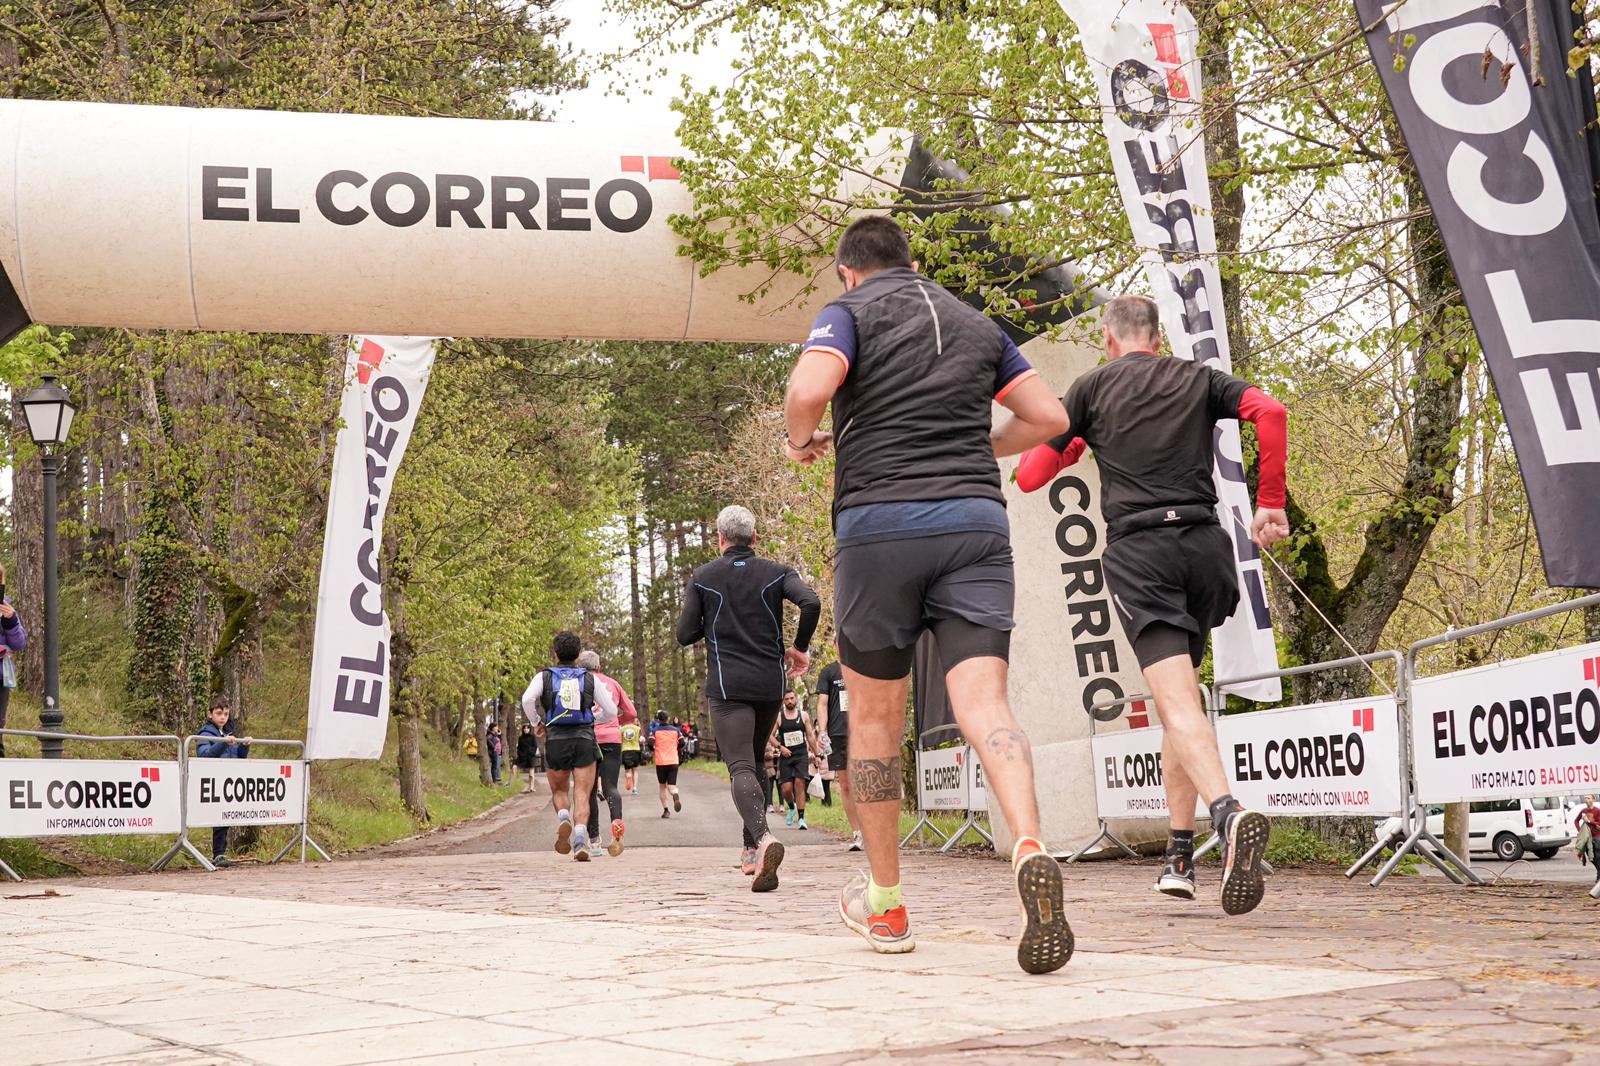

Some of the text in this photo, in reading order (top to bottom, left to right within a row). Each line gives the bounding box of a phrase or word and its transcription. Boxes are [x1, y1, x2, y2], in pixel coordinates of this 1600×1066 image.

[202, 165, 653, 233] EL CORREO
[1048, 475, 1125, 722] CORREO
[332, 640, 385, 718] EL
[1432, 688, 1600, 759] EL CORREO
[1104, 751, 1164, 789] EL CORR
[1233, 732, 1365, 781] EL CORREO
[200, 776, 286, 804] EL CORREO
[924, 765, 961, 791] EL CORREO
[1471, 768, 1536, 790] INFORMAZIO
[9, 780, 152, 809] EL CORREO
[1127, 798, 1161, 810] INFORMAZIO
[1267, 788, 1370, 807] INFORMACIÓN CON VALOR
[46, 815, 153, 829] INFORMACIÓN CON VALOR
[221, 808, 287, 821] INFORMACIÓN CON VALOR
